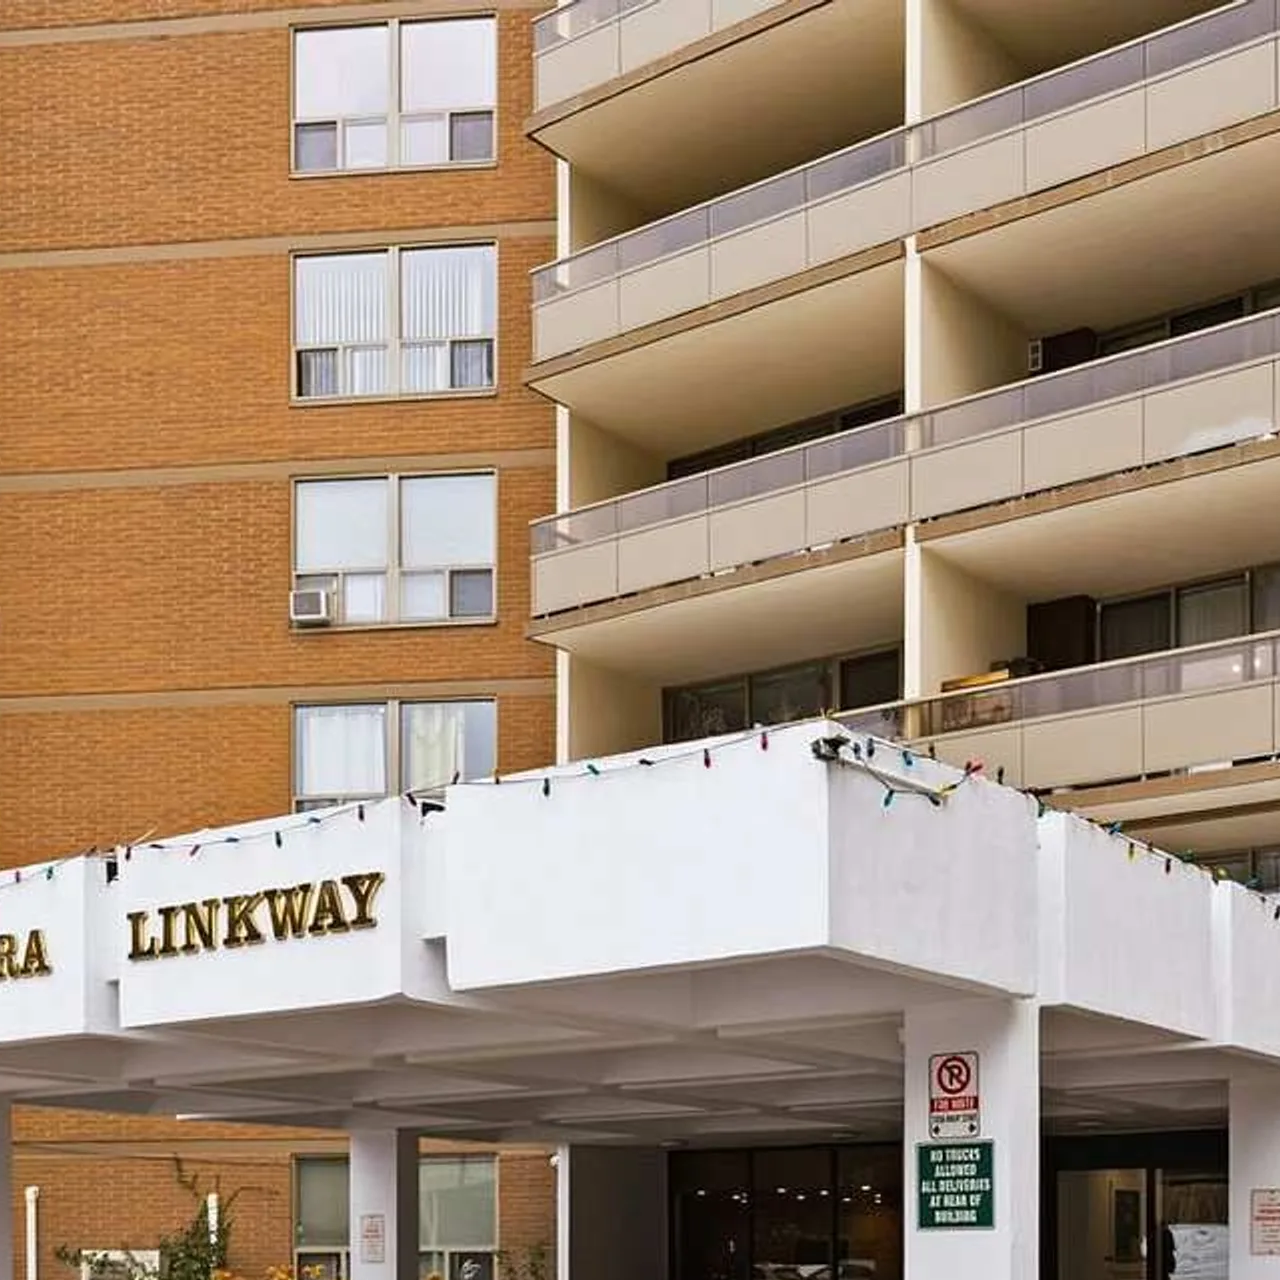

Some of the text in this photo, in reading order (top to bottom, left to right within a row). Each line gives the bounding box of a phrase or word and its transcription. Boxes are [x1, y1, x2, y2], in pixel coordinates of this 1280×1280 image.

[126, 871, 384, 962] LINKWAY
[930, 1148, 980, 1162] NO TRUCKS
[934, 1163, 977, 1177] ALLOWED
[922, 1178, 990, 1193] ALL DELIVERIES
